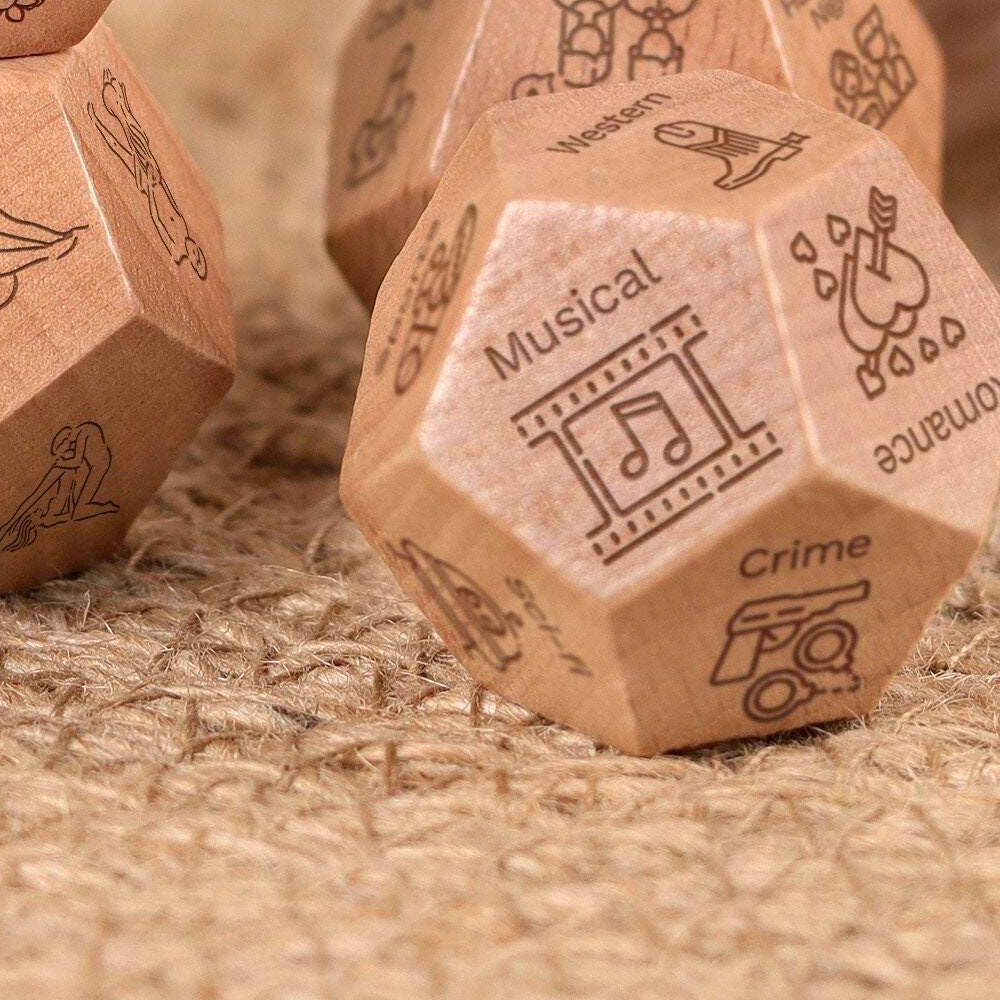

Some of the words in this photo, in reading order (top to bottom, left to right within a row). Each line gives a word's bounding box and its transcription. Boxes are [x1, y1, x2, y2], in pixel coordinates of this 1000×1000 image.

[546, 92, 671, 154] Western
[482, 248, 663, 381] Musical
[874, 377, 1000, 474] omance
[739, 535, 871, 579] Crime
